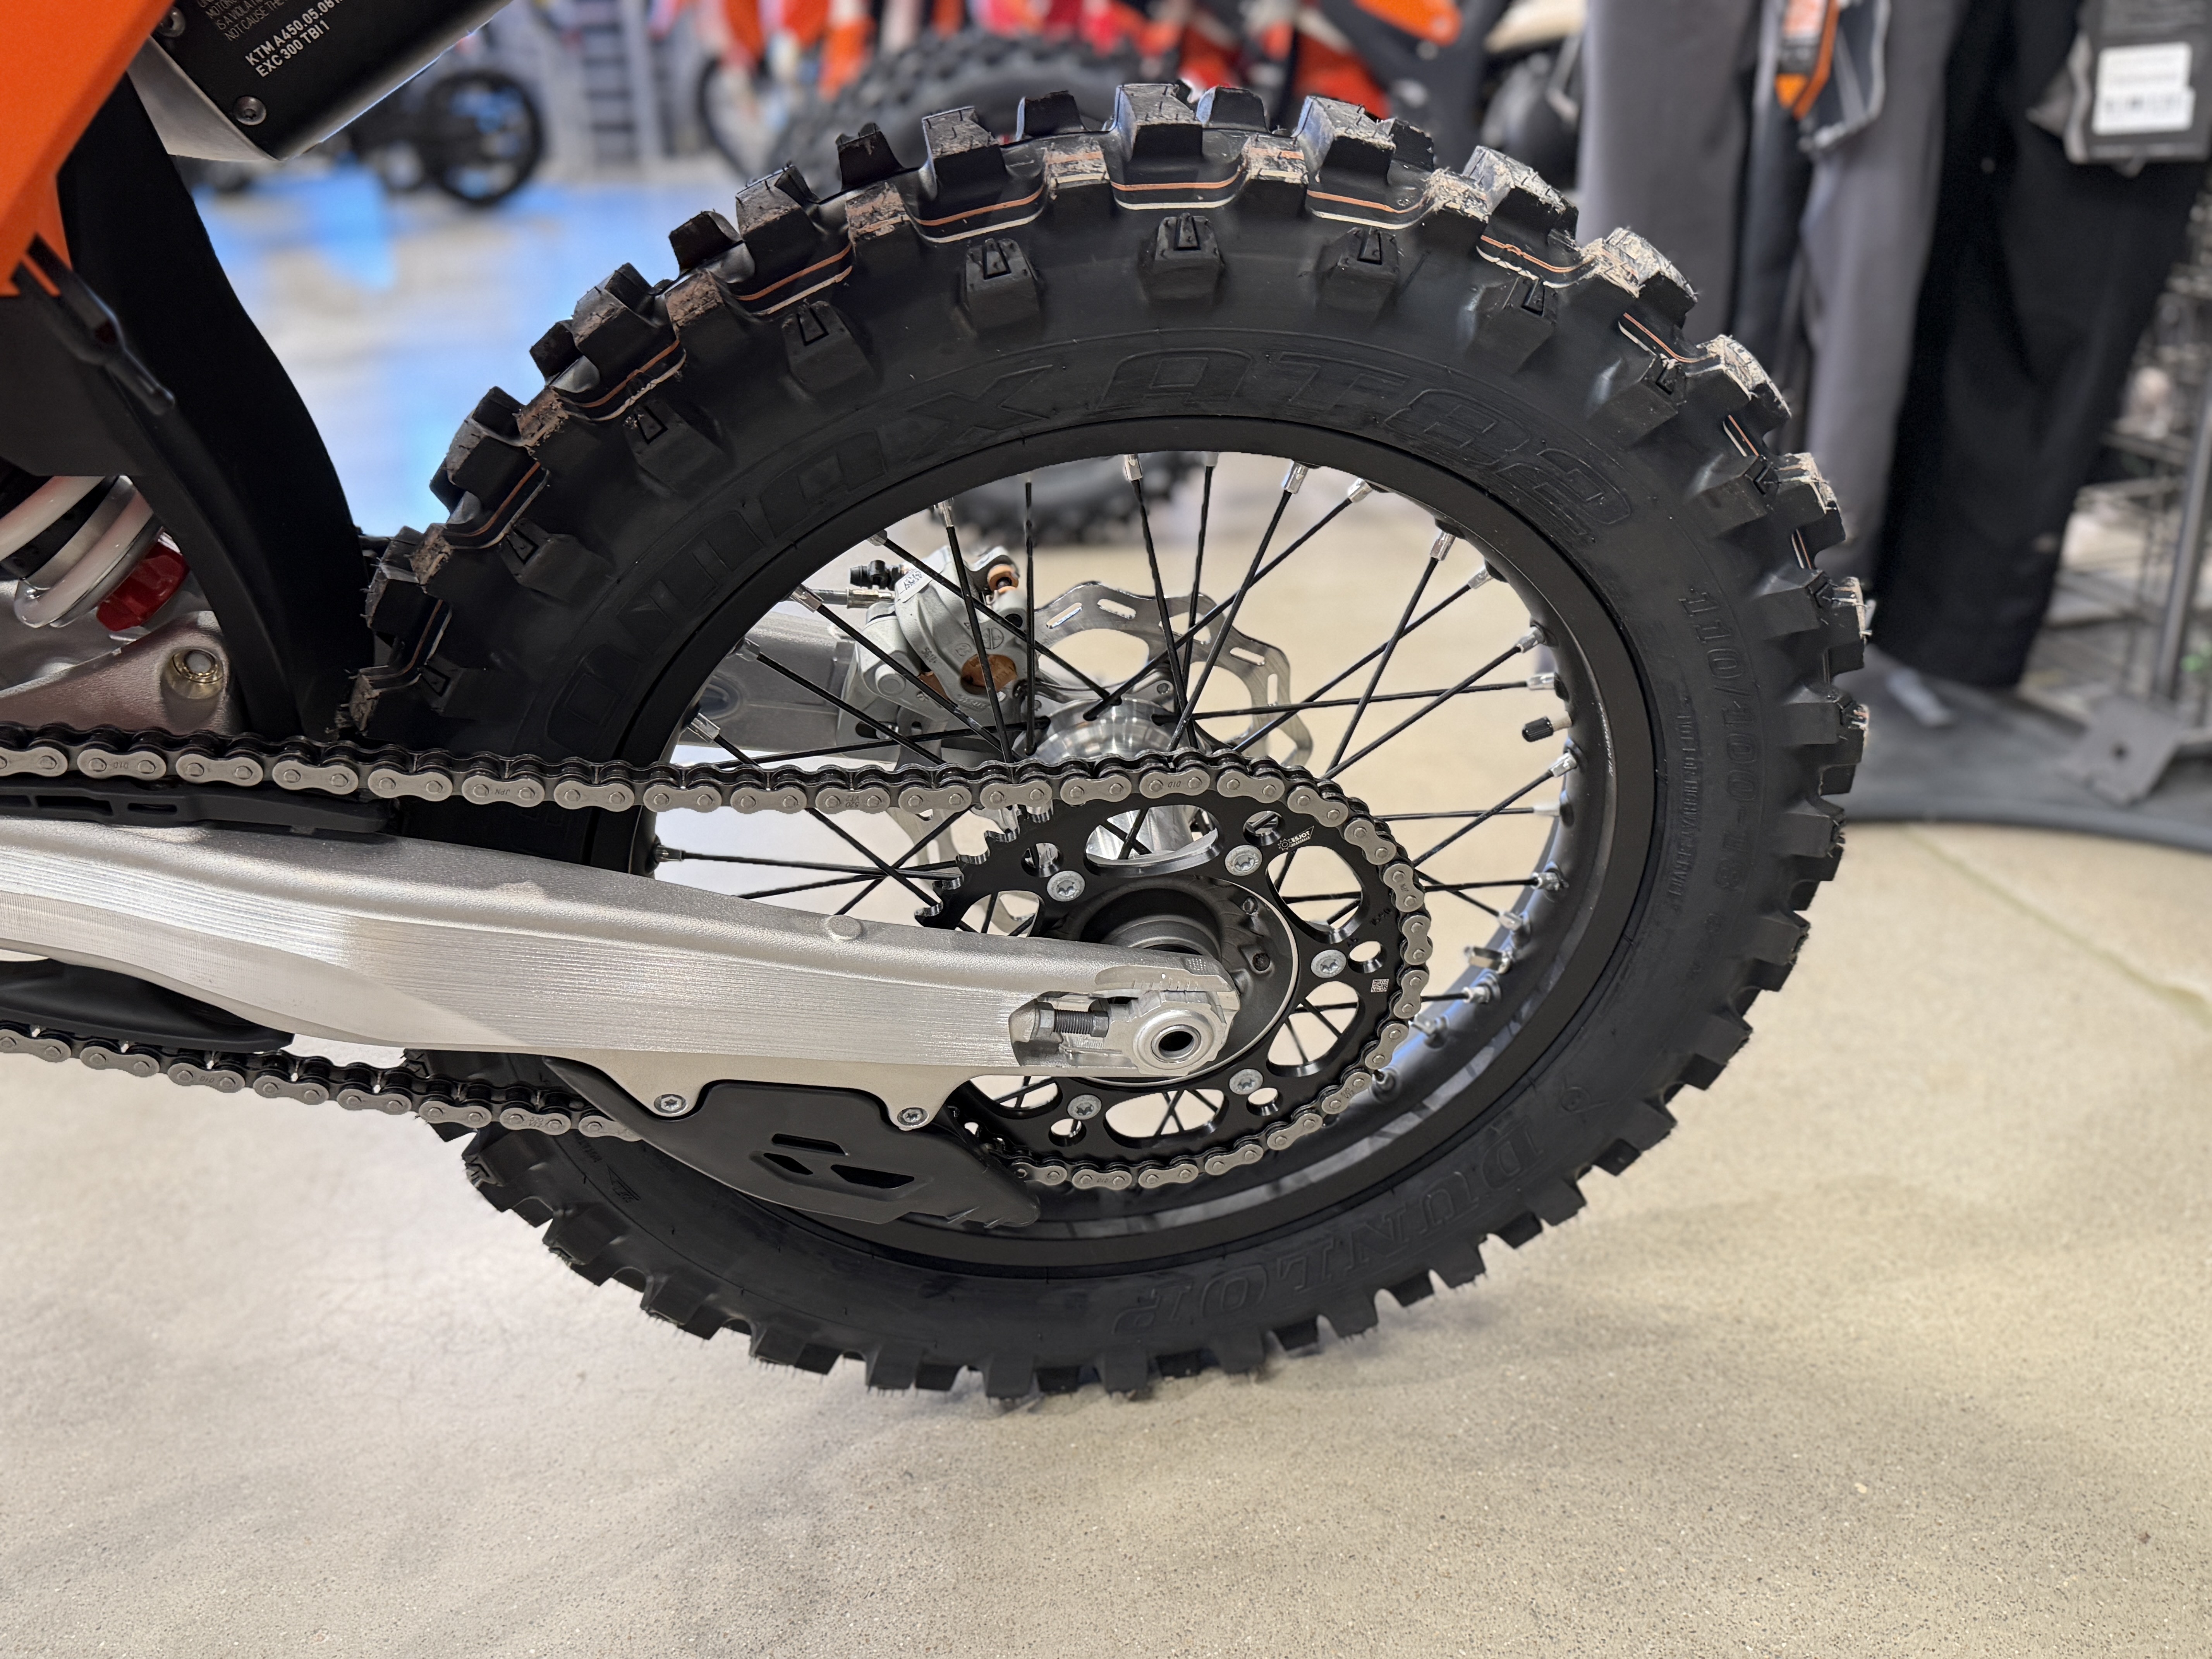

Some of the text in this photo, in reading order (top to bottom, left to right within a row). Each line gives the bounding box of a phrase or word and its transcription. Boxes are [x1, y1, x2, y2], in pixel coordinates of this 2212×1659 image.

[225, 24, 245, 41] NOT
[241, 6, 269, 29] CAUSE
[245, 41, 275, 66] KTM
[256, 20, 330, 77] EXC 300 TBI 1
[1111, 1114, 1544, 1335] DUNLOP
